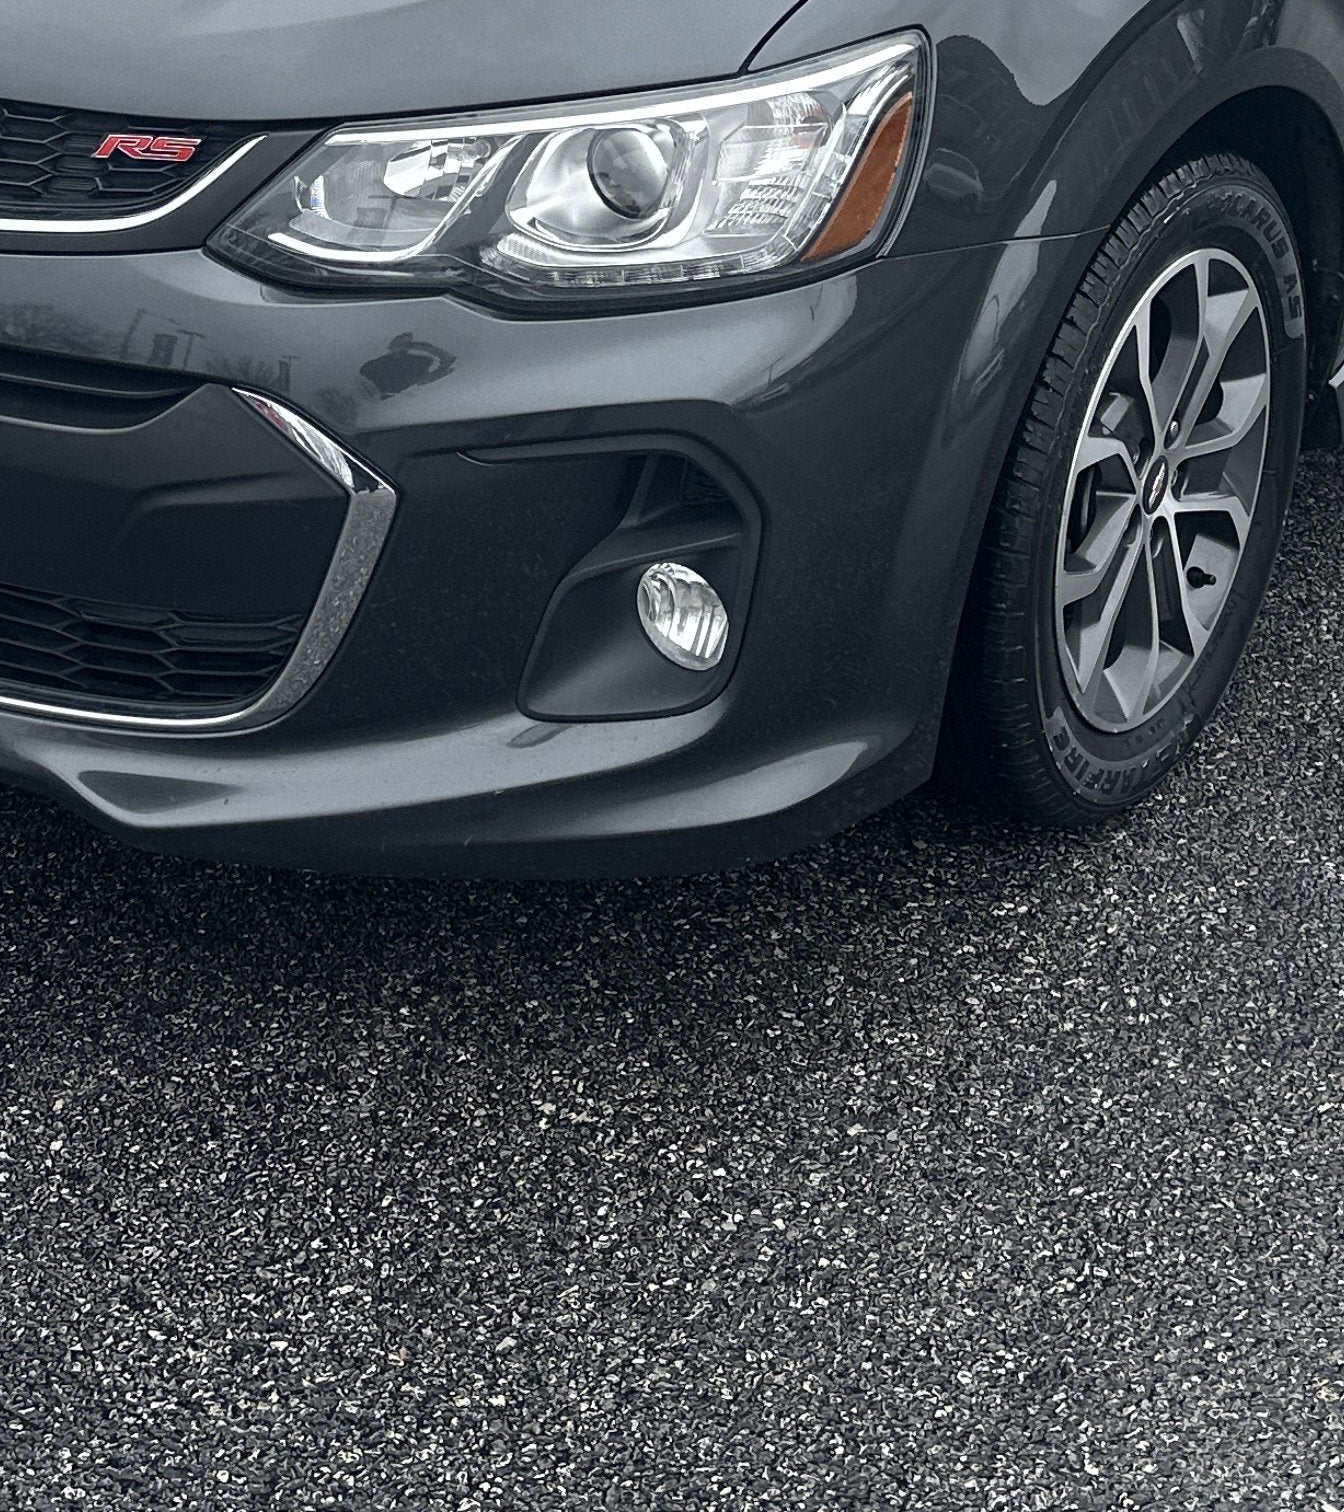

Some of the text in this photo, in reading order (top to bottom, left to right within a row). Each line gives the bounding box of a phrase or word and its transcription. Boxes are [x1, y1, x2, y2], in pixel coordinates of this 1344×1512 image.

[90, 134, 202, 162] RS
[1207, 192, 1302, 319] LARUS AS
